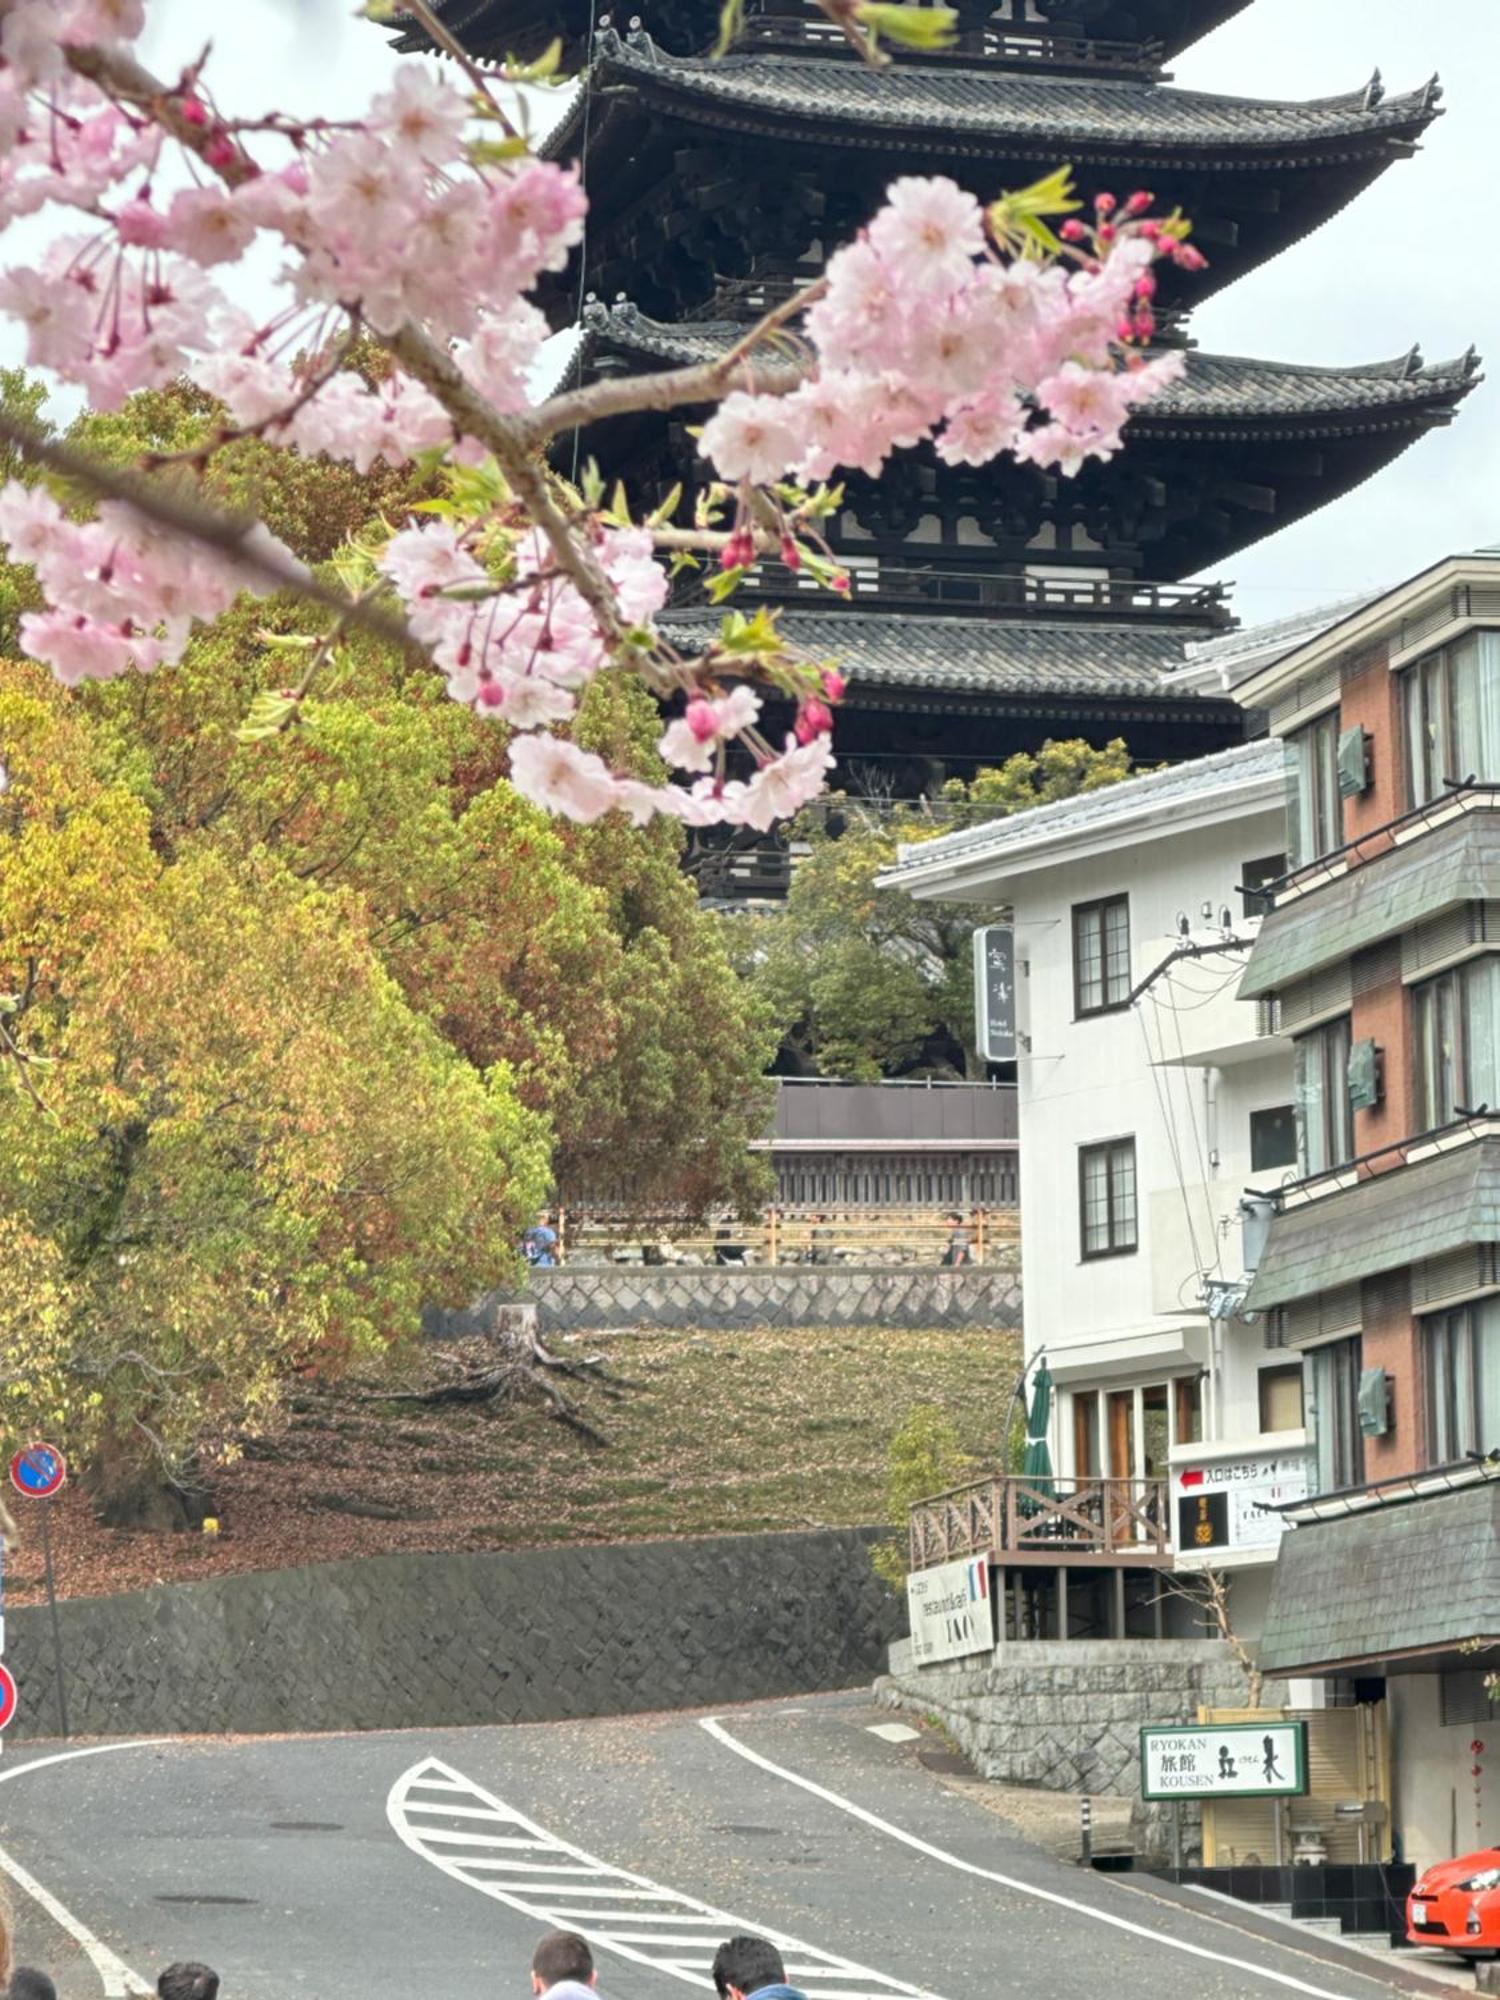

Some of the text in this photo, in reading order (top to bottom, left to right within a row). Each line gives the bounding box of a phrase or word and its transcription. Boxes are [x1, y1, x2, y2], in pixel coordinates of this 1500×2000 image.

[1206, 1464, 1258, 1484] 入口はこちら
[1151, 1738, 1207, 1752] RYOKAN
[1161, 1754, 1197, 1772] 旅館
[1160, 1774, 1214, 1788] KOUSEN
